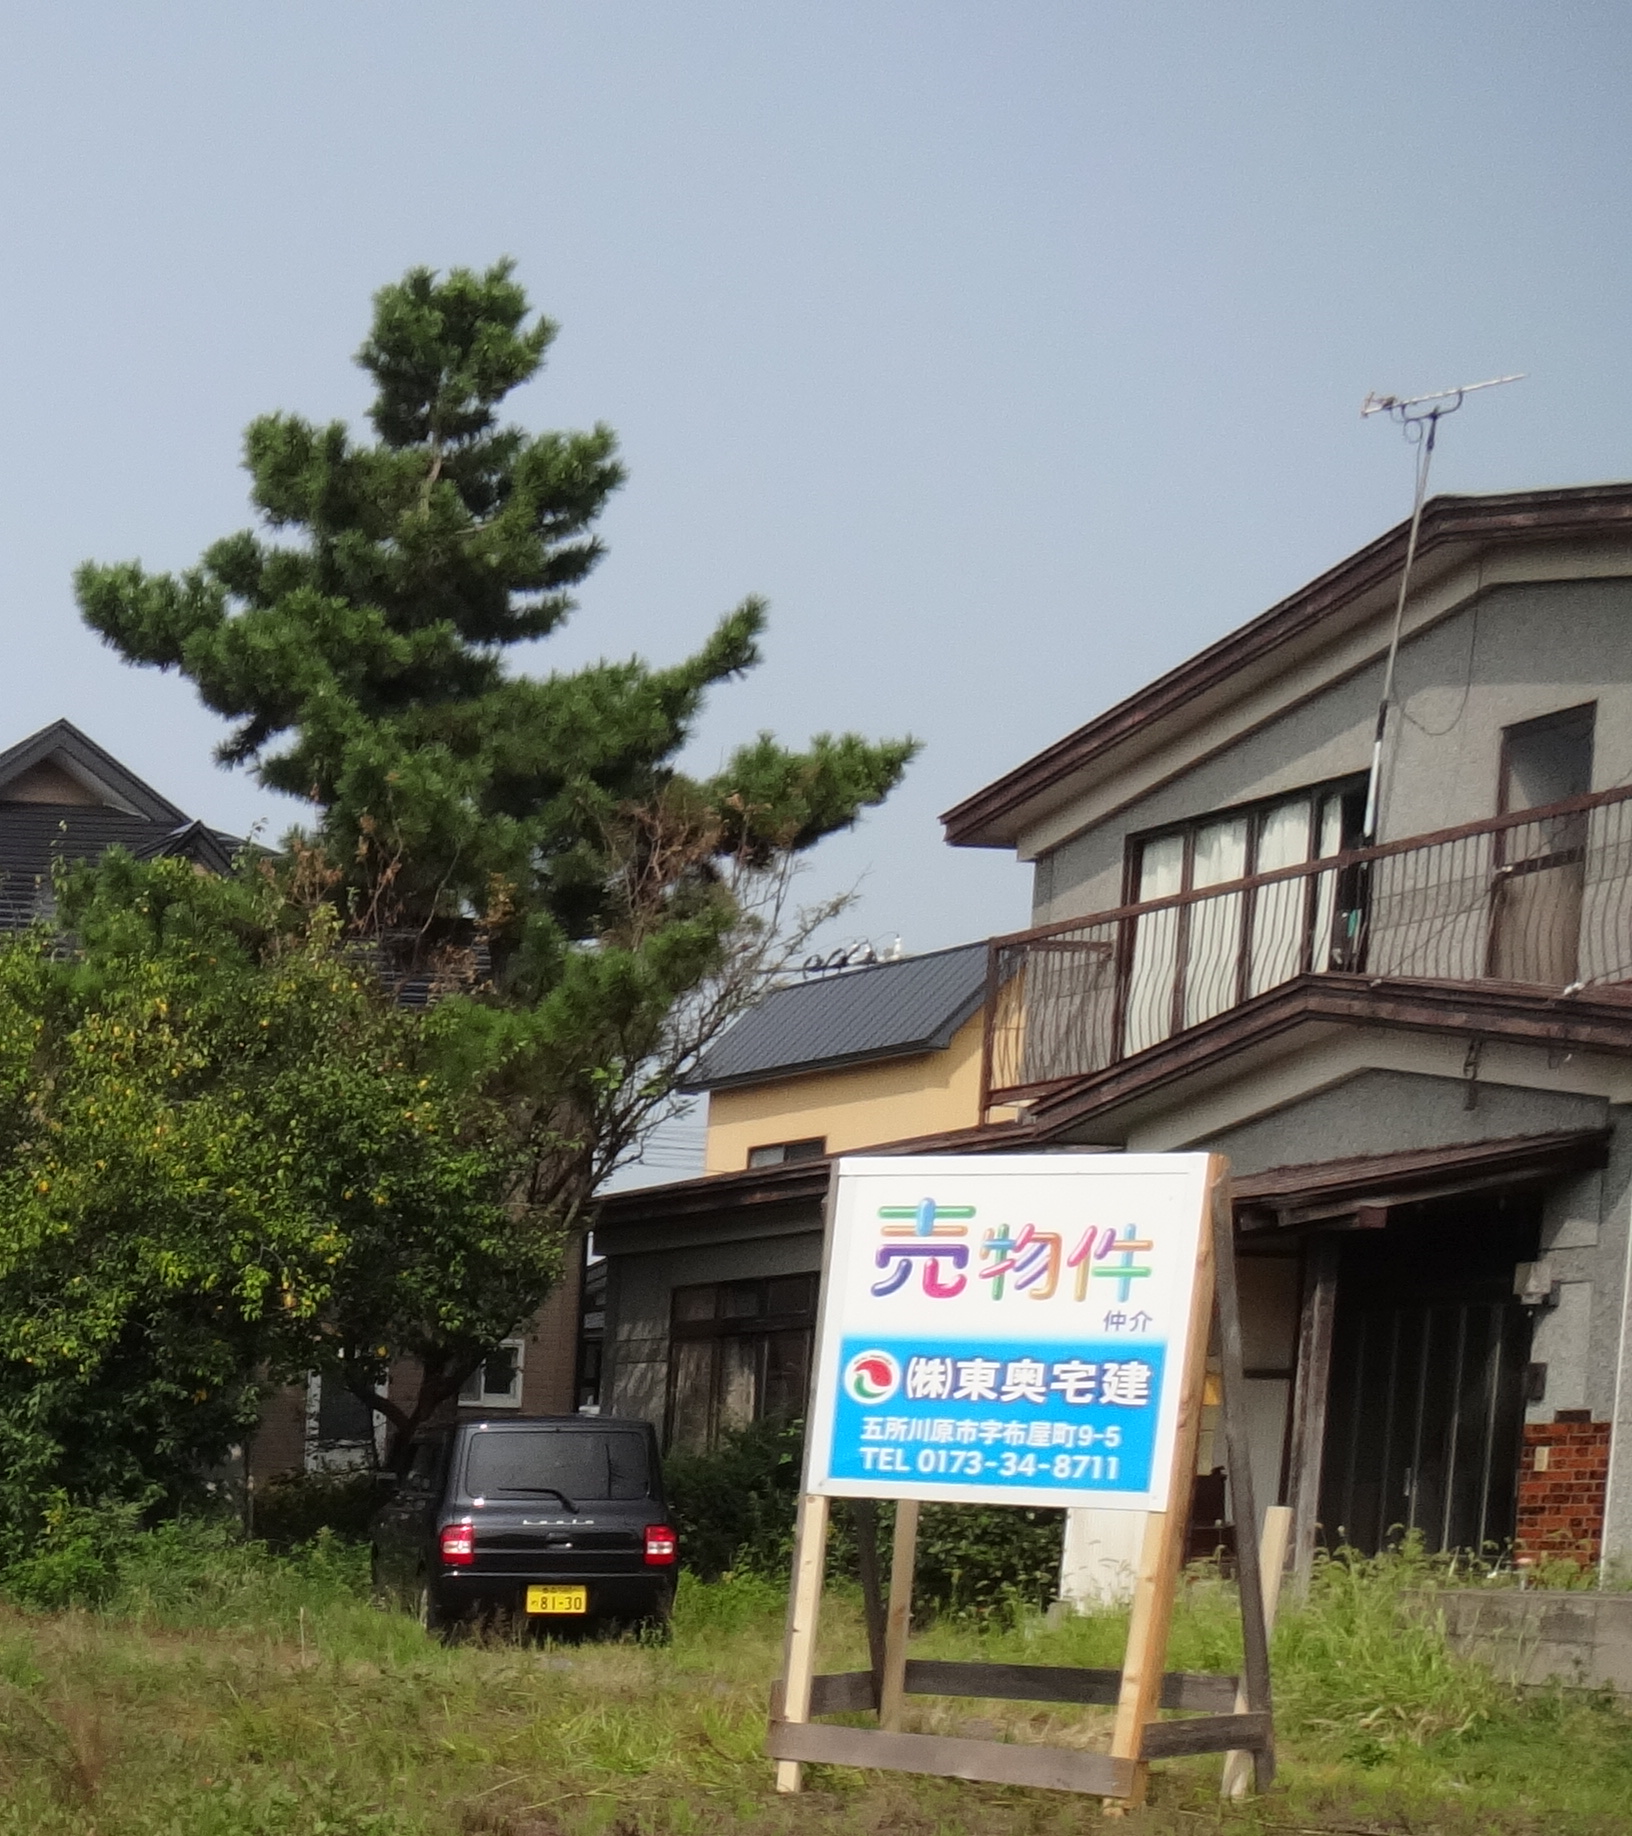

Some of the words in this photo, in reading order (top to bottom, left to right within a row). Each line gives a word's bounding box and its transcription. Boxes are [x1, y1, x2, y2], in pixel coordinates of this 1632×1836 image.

[870, 1197, 1154, 1302] 売物件
[1103, 1310, 1153, 1333] 仲介
[859, 1447, 909, 1472] TEL
[917, 1449, 1120, 1480] 0173-34-8711
[540, 1597, 582, 1611] 81-30
